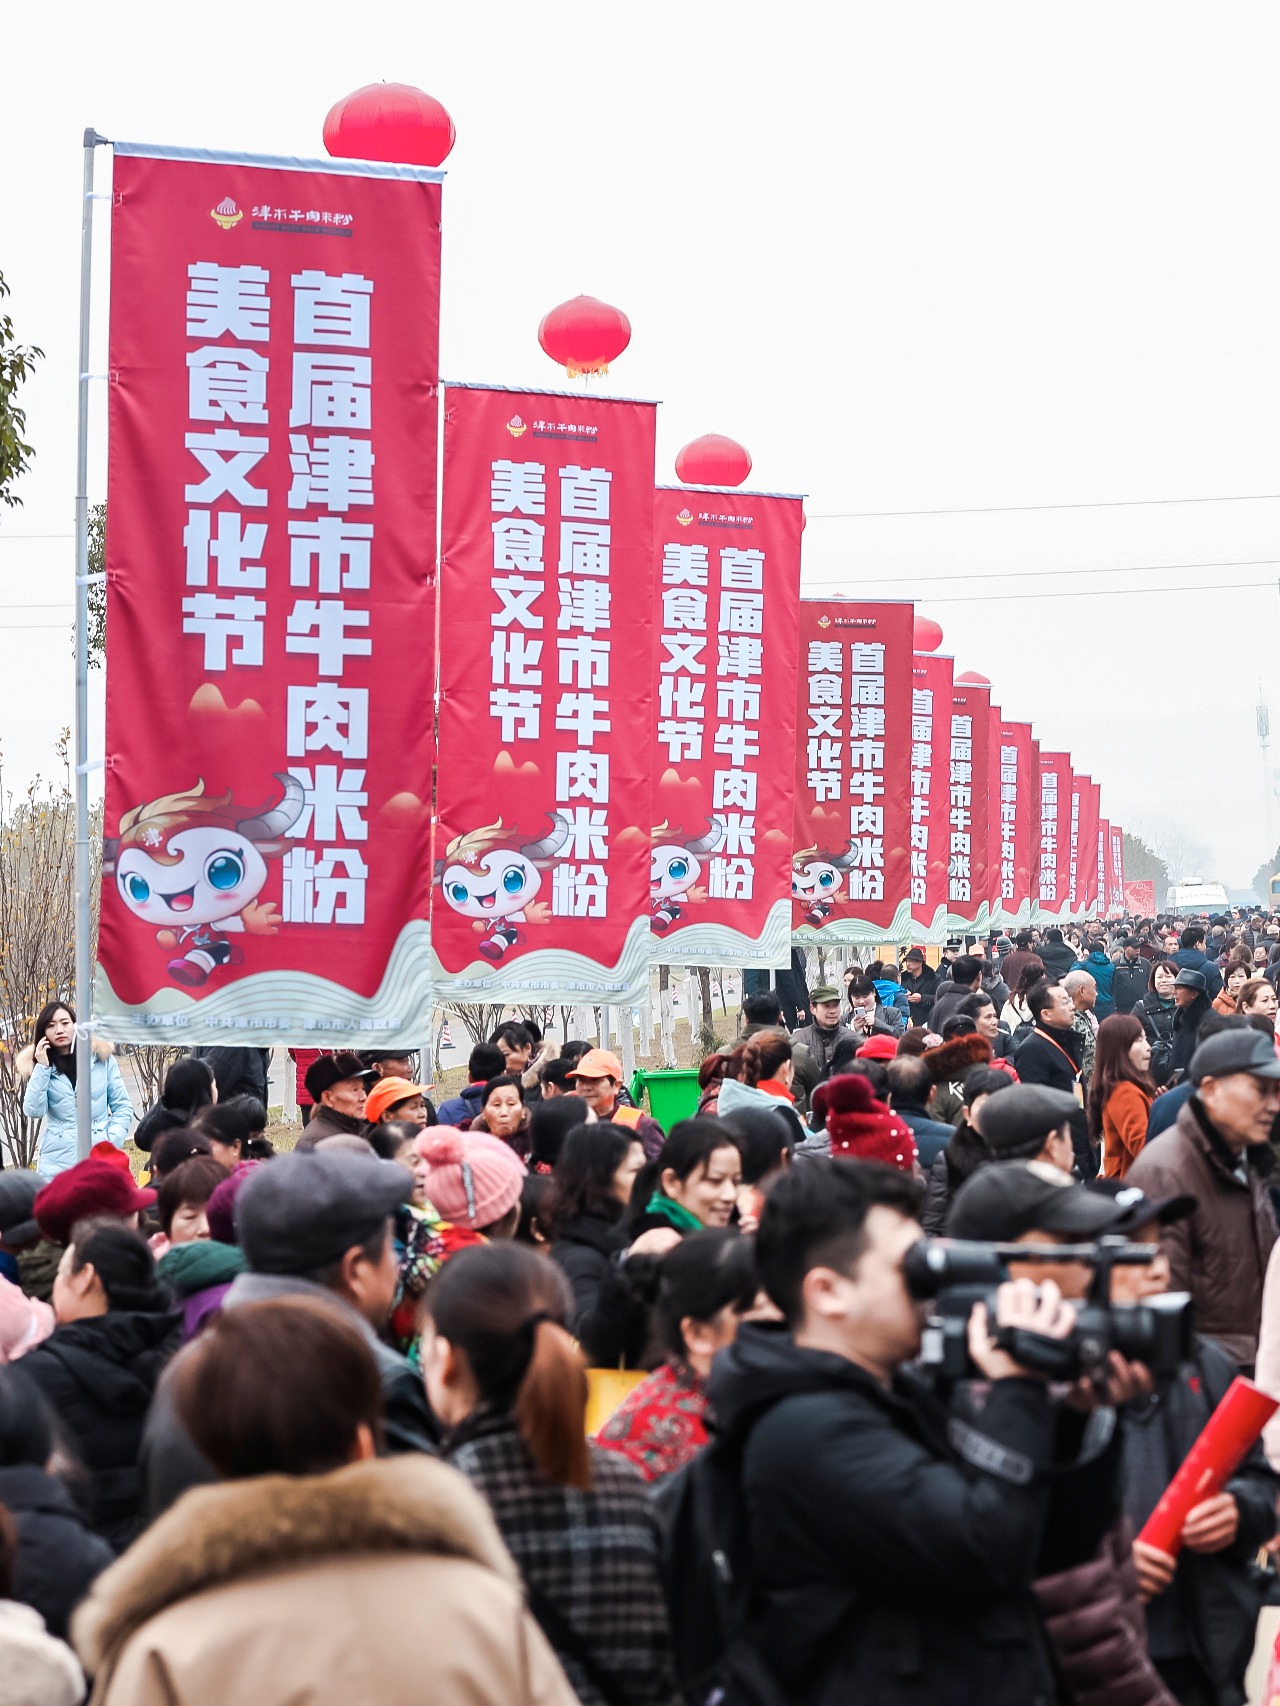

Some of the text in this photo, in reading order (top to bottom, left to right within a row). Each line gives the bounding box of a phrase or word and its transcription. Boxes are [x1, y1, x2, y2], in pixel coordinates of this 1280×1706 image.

[182, 262, 270, 671] 美食文化节
[282, 269, 375, 925] 首届津市牛肉米粉
[490, 460, 546, 742] 美食文化节
[552, 464, 613, 918] 首届津市牛肉米粉
[657, 543, 709, 770] 美食文化节
[708, 546, 766, 900] 首届津市牛肉米粉
[806, 641, 843, 802] 美食文化节
[848, 641, 886, 901] 首届津市牛肉米粉
[949, 714, 973, 902] 首届津市牛肉米粉
[1039, 772, 1058, 901] 首届津市牛肉米粉
